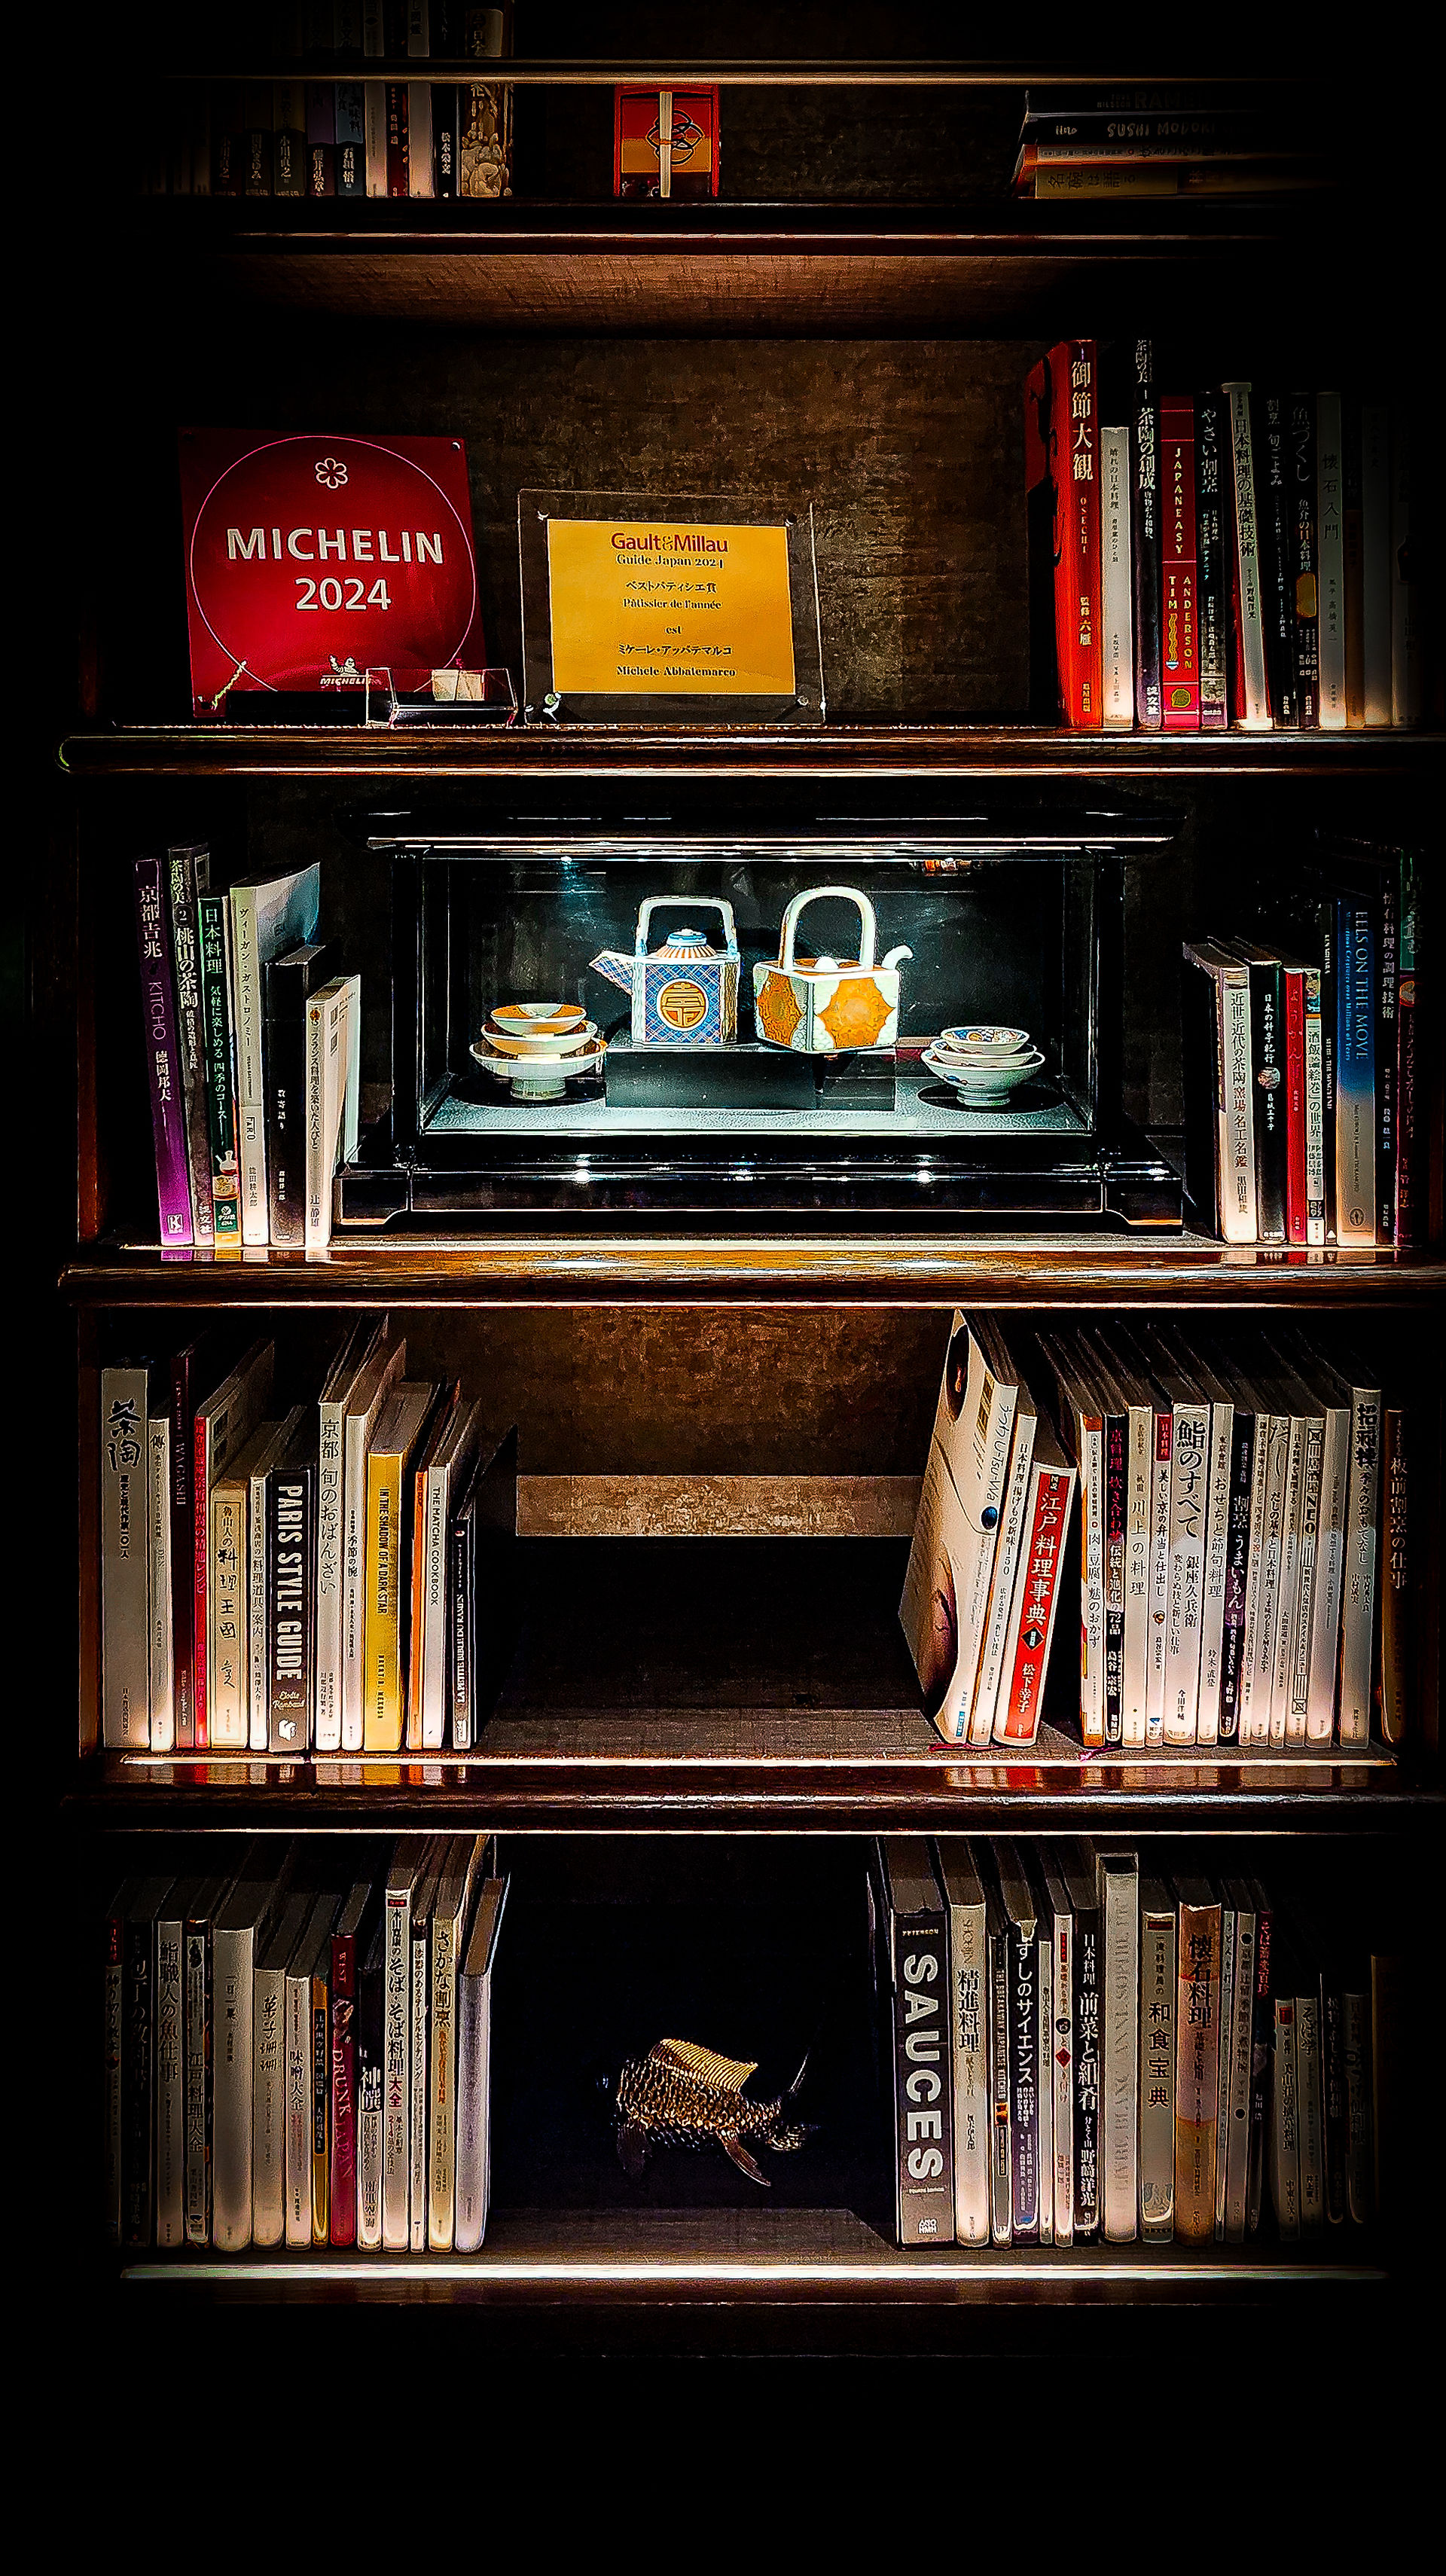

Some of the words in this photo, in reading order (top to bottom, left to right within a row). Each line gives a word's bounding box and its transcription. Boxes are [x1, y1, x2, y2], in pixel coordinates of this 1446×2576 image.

[1107, 122, 1150, 138] SUSHI
[1072, 361, 1094, 481] 御節大観
[1173, 447, 1185, 554] JAPANEASY
[1235, 418, 1256, 558] 日本料理の基礎技術
[1322, 453, 1339, 540] 懐石入門
[227, 529, 443, 563] MICHELIN
[611, 533, 729, 554] Gault&Millau
[616, 554, 652, 566] Guide
[654, 556, 692, 569] Japan
[295, 578, 391, 611] 2024
[1168, 575, 1178, 609] TIM
[1182, 575, 1193, 670] ANDERSON
[666, 626, 682, 635] est
[139, 885, 163, 960] 京都吉兆
[205, 908, 224, 975] 日本料理
[1355, 911, 1368, 943] EELS
[175, 927, 199, 1009] 桃山の茶陶
[1355, 948, 1368, 973] ON
[148, 981, 166, 1040] KITCHO
[1355, 977, 1368, 1009] THE
[1355, 1014, 1369, 1060] MOVE
[321, 1418, 340, 1460] 京都
[432, 1487, 441, 1506] THE
[1176, 1420, 1206, 1539] 鮨のすべて
[276, 1485, 304, 1543] PARIS
[319, 1467, 339, 1595] 旬のおばんざい
[378, 1515, 389, 1550] SHADOW
[432, 1507, 441, 1547] MATCHA
[1207, 1476, 1228, 1598] おせちと節句料理
[378, 1551, 389, 1562] OF
[1025, 1494, 1062, 1626] 江戸料理事典
[1129, 1499, 1146, 1596] 川上の料理
[276, 1552, 304, 1612] STYLE
[377, 1570, 389, 1592] DARK
[377, 1594, 388, 1614] STAR
[430, 1549, 441, 1606] COOKBOOK
[276, 1620, 303, 1680] GUIDE
[434, 1930, 453, 2028] さかな割烹
[1082, 1934, 1097, 1985] 日本料理
[158, 1940, 179, 2083] 鮨職人の魚仕事
[957, 1969, 981, 2053] 精進料理
[1015, 1937, 1035, 2084] すしのサイエンス
[903, 1954, 944, 2180] SAUCES
[1147, 2001, 1171, 2108] 和食宝典
